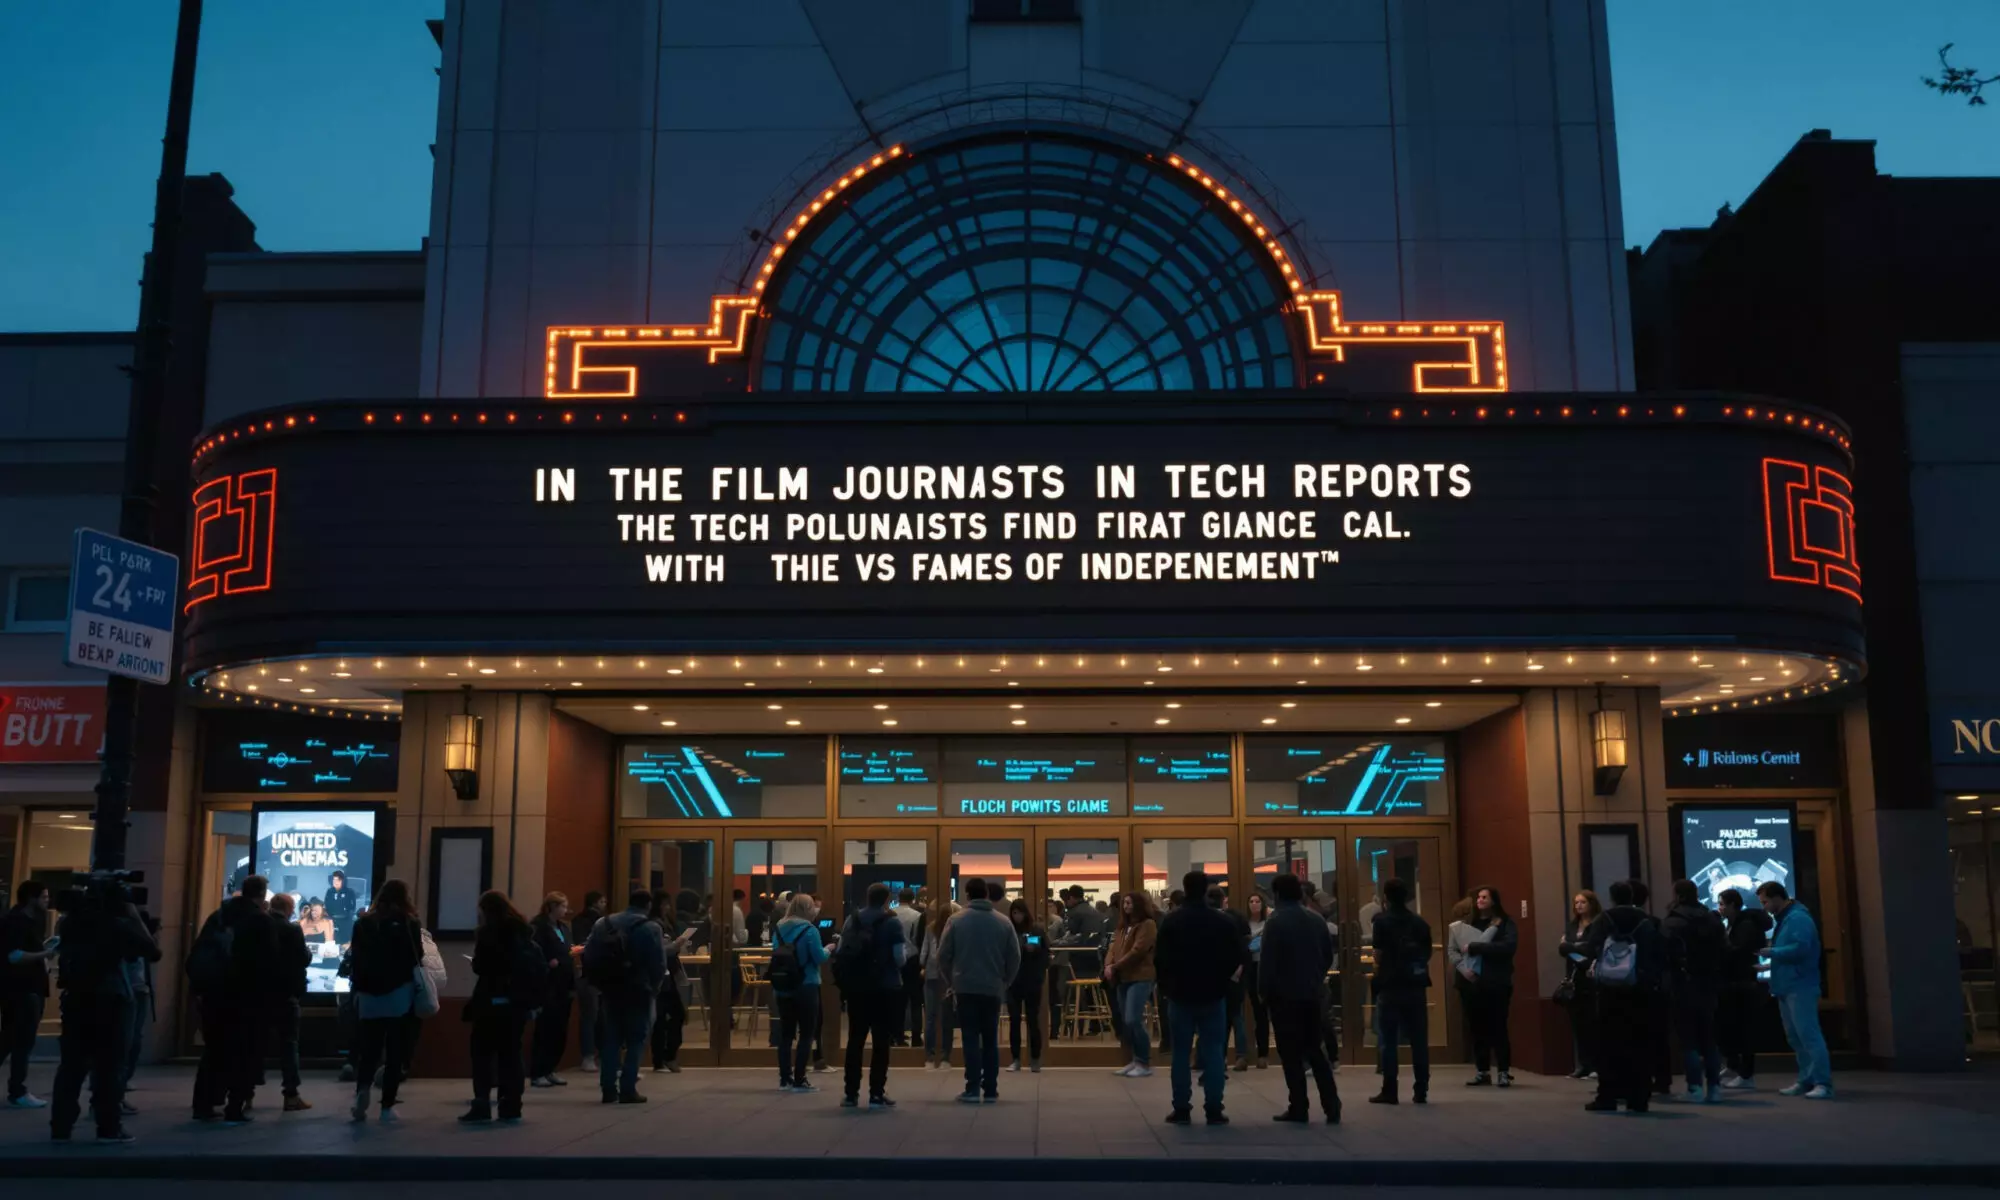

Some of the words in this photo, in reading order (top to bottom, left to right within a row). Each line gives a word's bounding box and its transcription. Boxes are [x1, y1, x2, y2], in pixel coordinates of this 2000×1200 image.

[536, 468, 575, 502] IN
[609, 467, 683, 502] THE
[712, 466, 808, 501] FILM
[833, 465, 1065, 500] JOURNASTS
[1096, 465, 1135, 499] IN
[1165, 464, 1265, 499] TECH
[1294, 463, 1472, 498] REPORTS
[617, 514, 676, 542] THE
[690, 513, 769, 542] TECH
[787, 512, 987, 541] POLUNAISTS
[1004, 511, 1077, 539] FIND
[1098, 511, 1186, 539] FIRAT
[1202, 510, 1317, 539] GIANCE
[1343, 510, 1411, 539] CAL.
[645, 554, 725, 583] WITH
[771, 553, 840, 582] THIE
[856, 553, 896, 582] VS
[912, 553, 1013, 582] FAMES
[1025, 552, 1064, 581] OF
[88, 621, 105, 639] BE
[3, 713, 94, 747] BUTT
[1011, 799, 1061, 813] POWITS
[280, 849, 349, 868] CINEMAS
